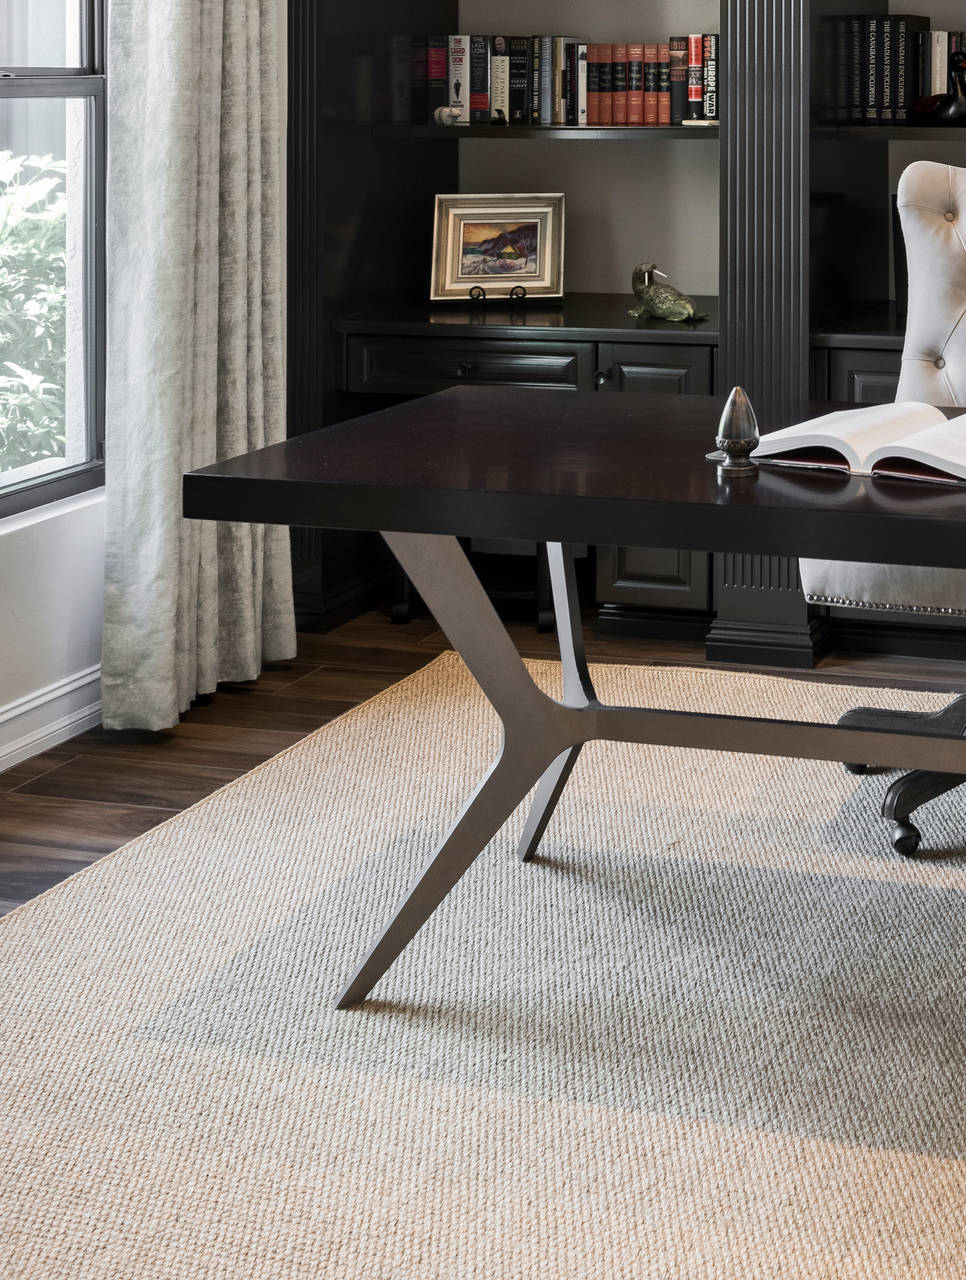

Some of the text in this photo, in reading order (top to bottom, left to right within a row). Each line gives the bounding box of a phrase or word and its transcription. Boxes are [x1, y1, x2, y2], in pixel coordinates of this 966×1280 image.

[868, 19, 877, 32] THE
[883, 20, 891, 32] THE
[868, 32, 877, 64] CANADIAN
[883, 32, 891, 64] CANADIAN
[707, 60, 716, 92] EUROPE
